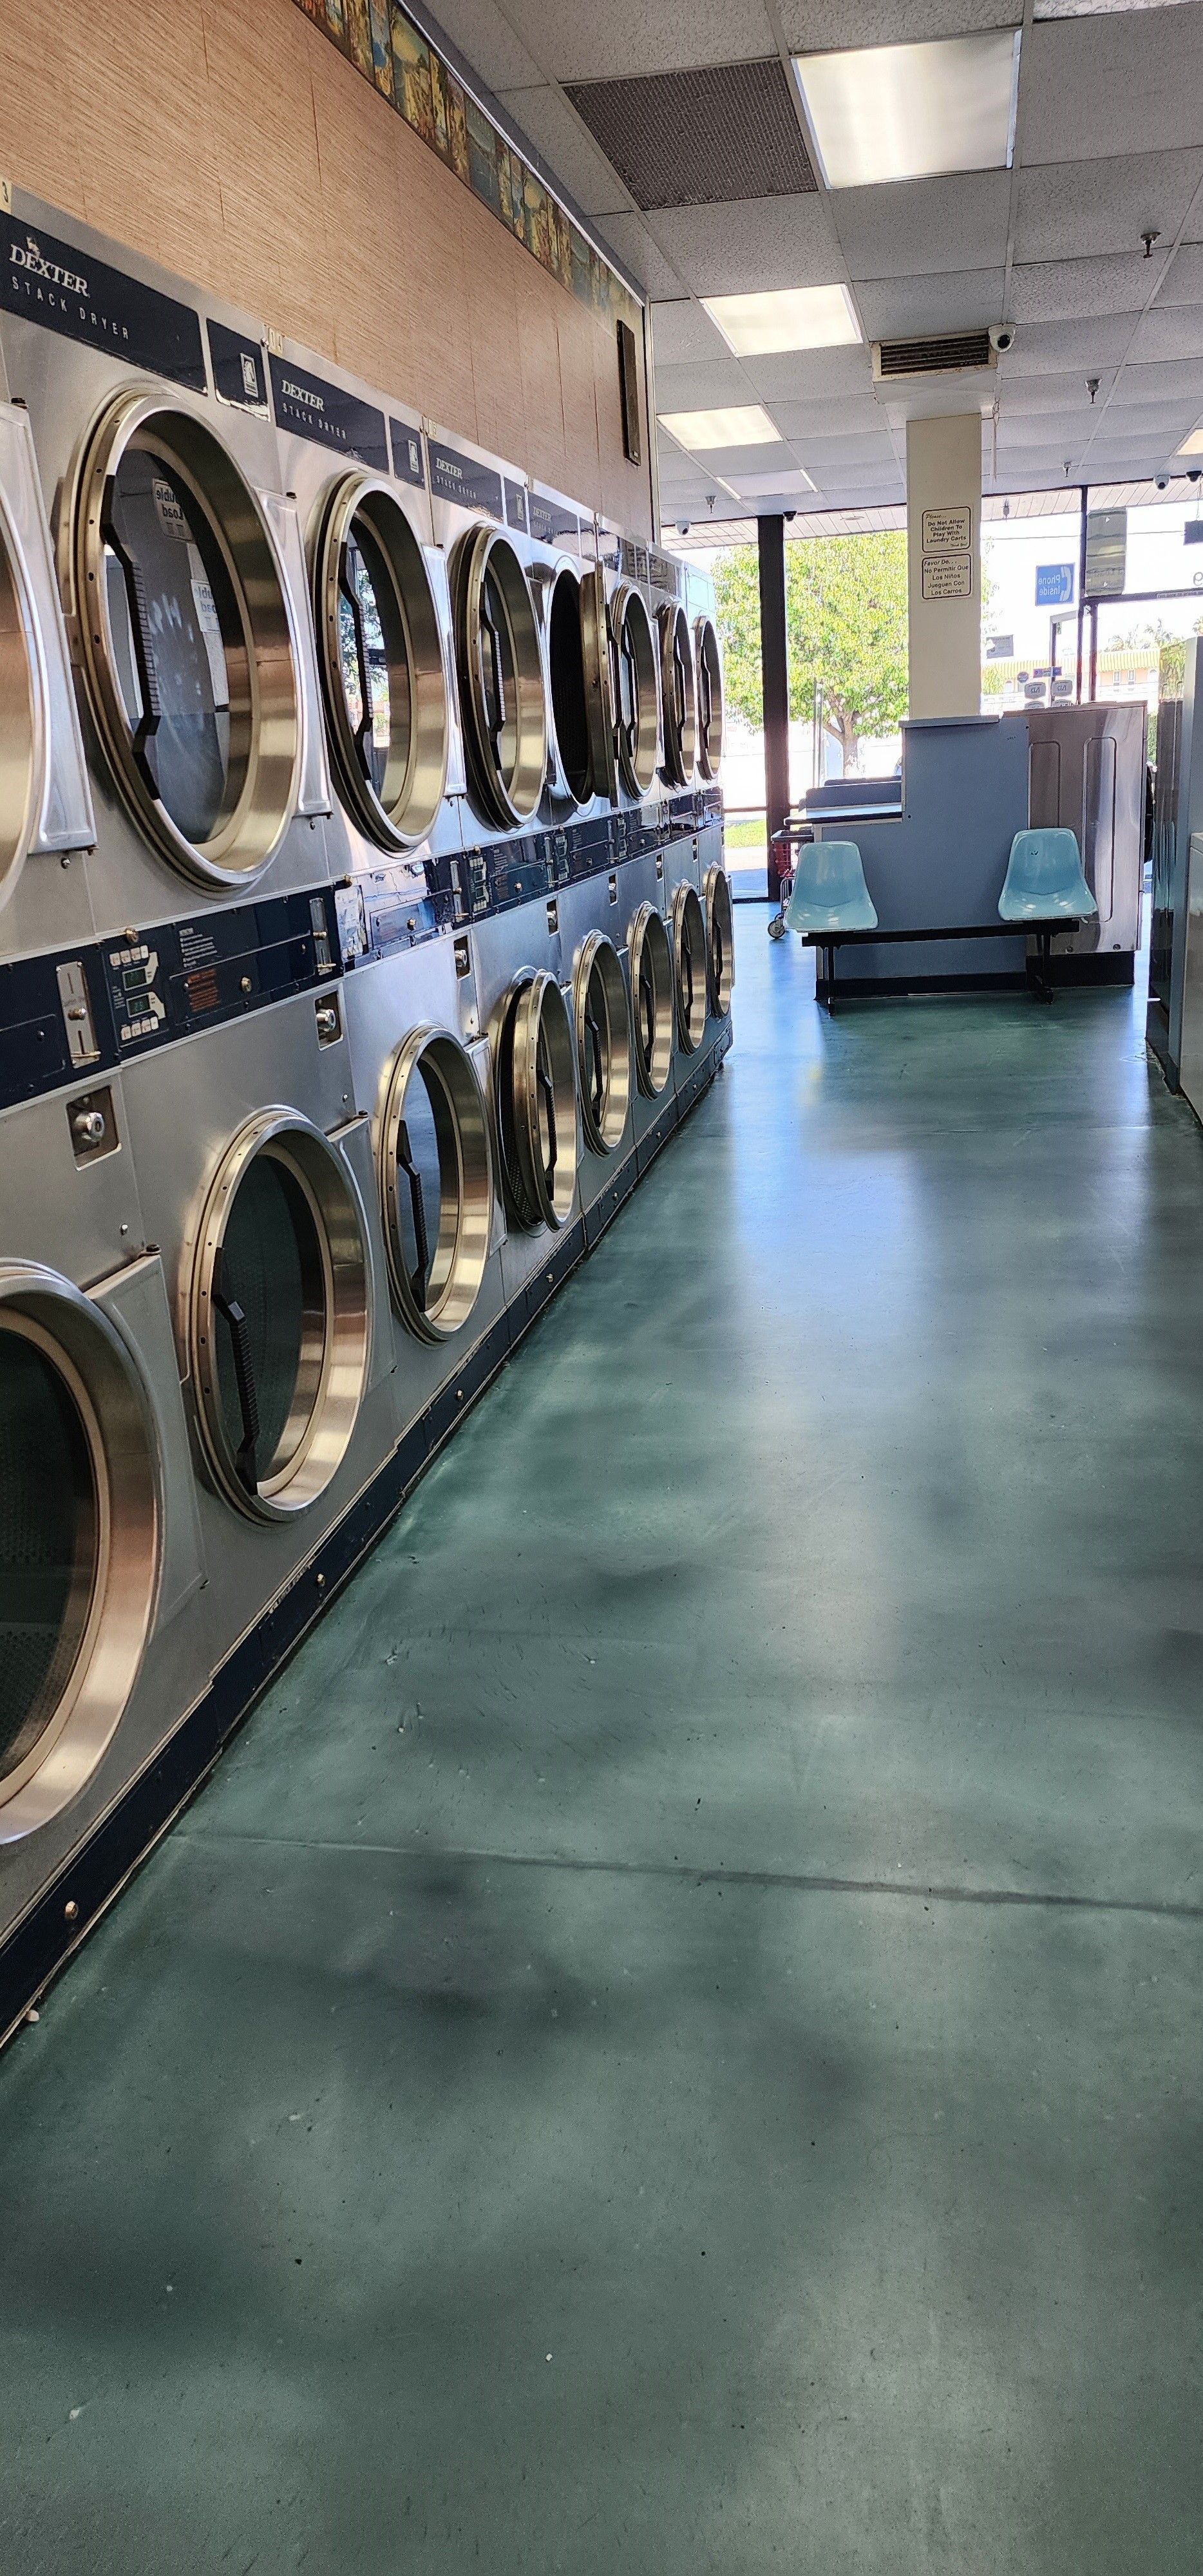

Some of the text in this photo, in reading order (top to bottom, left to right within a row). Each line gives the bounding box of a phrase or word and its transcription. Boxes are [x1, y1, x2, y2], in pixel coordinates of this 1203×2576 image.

[9, 243, 90, 298] DEXTER
[12, 276, 129, 339] STACK DRYER
[281, 380, 325, 412] DEXTER
